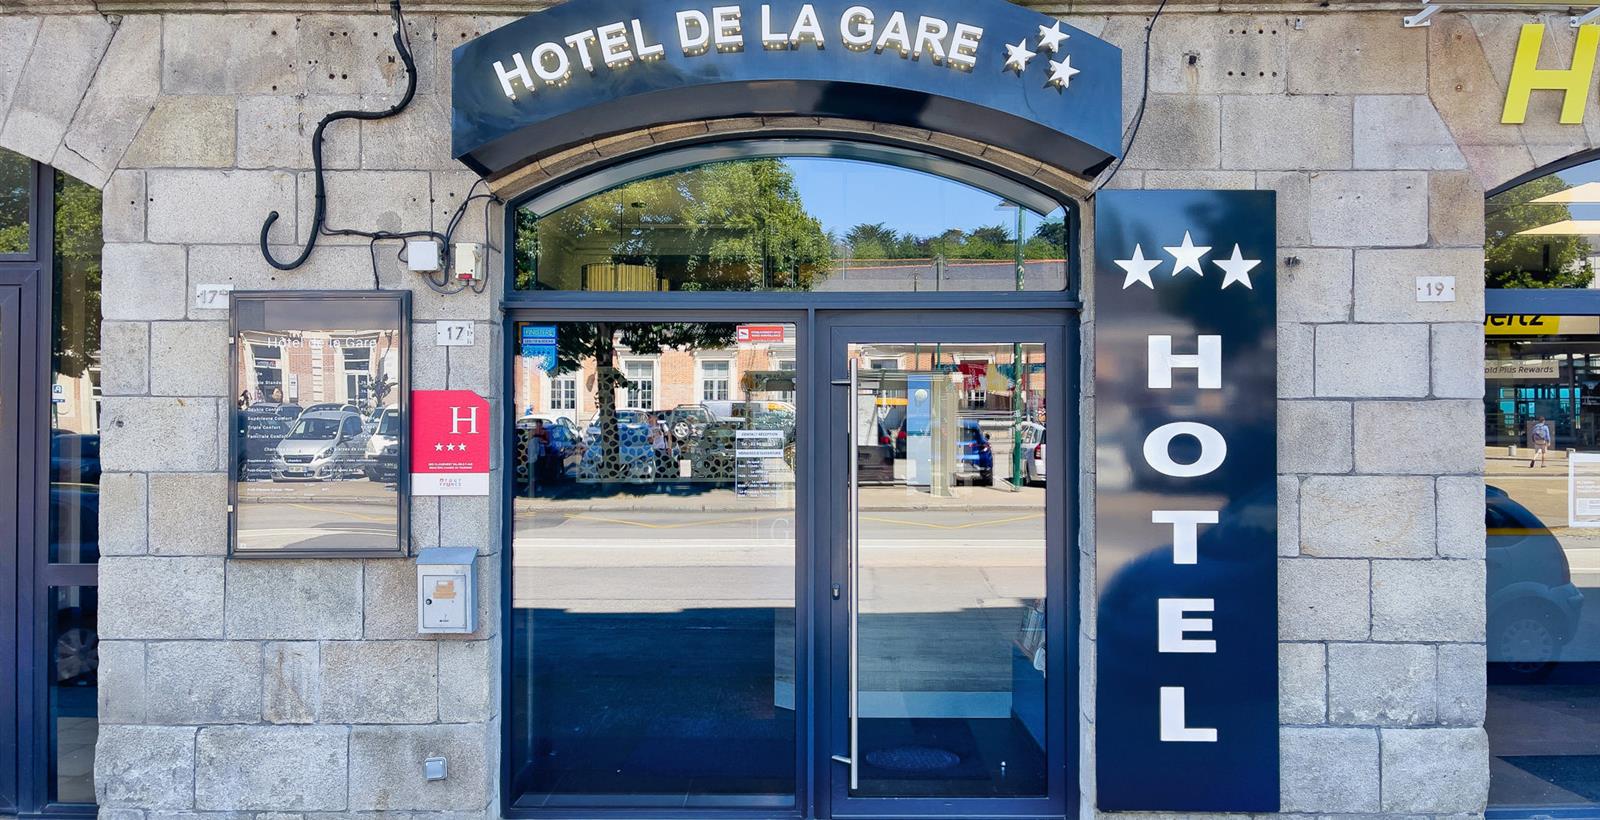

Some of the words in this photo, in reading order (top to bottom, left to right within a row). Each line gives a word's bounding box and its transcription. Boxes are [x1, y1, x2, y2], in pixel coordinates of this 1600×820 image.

[492, 19, 664, 99] HOTEL
[675, 5, 743, 53] DE
[761, 3, 825, 47] LA
[840, 5, 984, 69] GARE
[1425, 281, 1445, 296] 19
[1483, 314, 1543, 326] ertz
[447, 326, 465, 340] 17
[267, 336, 304, 348] Hôtel
[328, 336, 341, 348] la
[345, 336, 377, 348] Gare
[1499, 366, 1517, 374] Plus
[1518, 366, 1554, 374] Rewards
[449, 406, 480, 434] H
[1142, 334, 1227, 742] HOTEL
